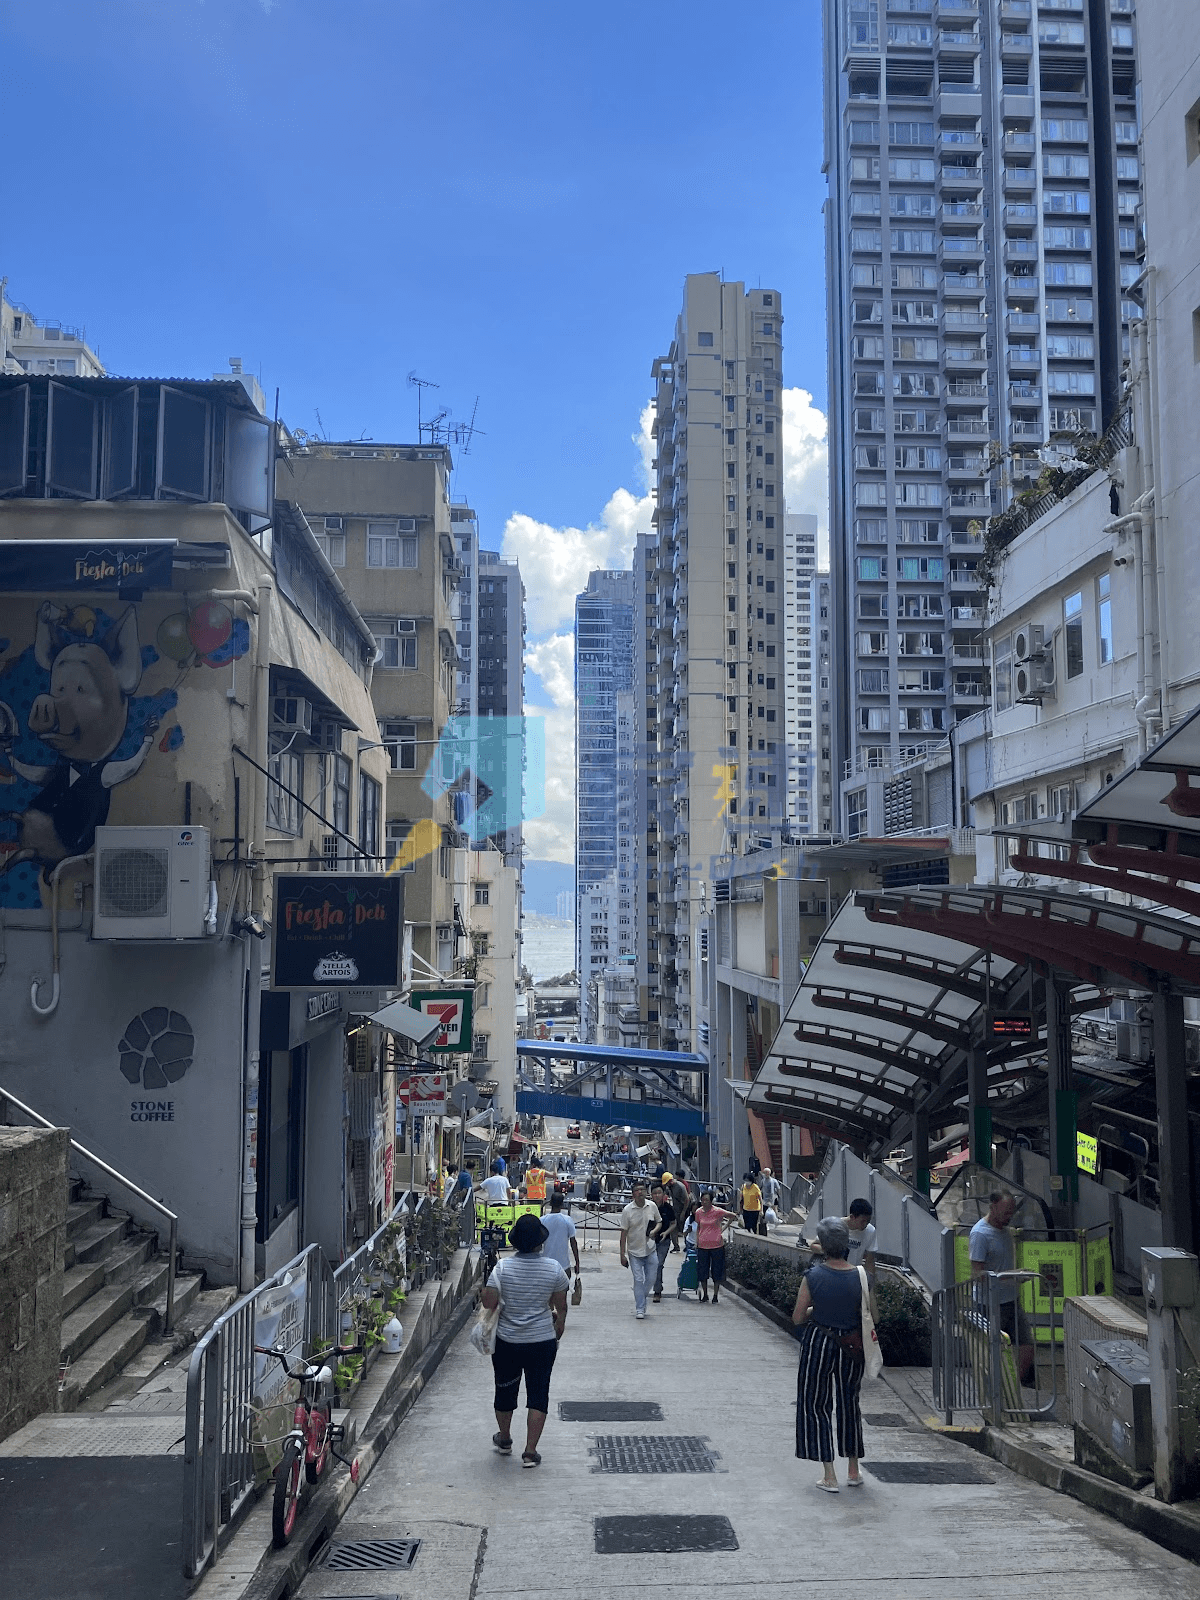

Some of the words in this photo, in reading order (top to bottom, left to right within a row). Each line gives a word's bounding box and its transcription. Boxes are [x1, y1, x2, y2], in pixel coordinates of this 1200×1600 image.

[75, 559, 117, 581] Fiesta
[122, 561, 144, 577] Deli
[285, 900, 347, 931] Fiesta
[354, 903, 387, 925] Deli
[130, 1101, 174, 1111] STONE
[130, 1112, 175, 1122] COFFEE
